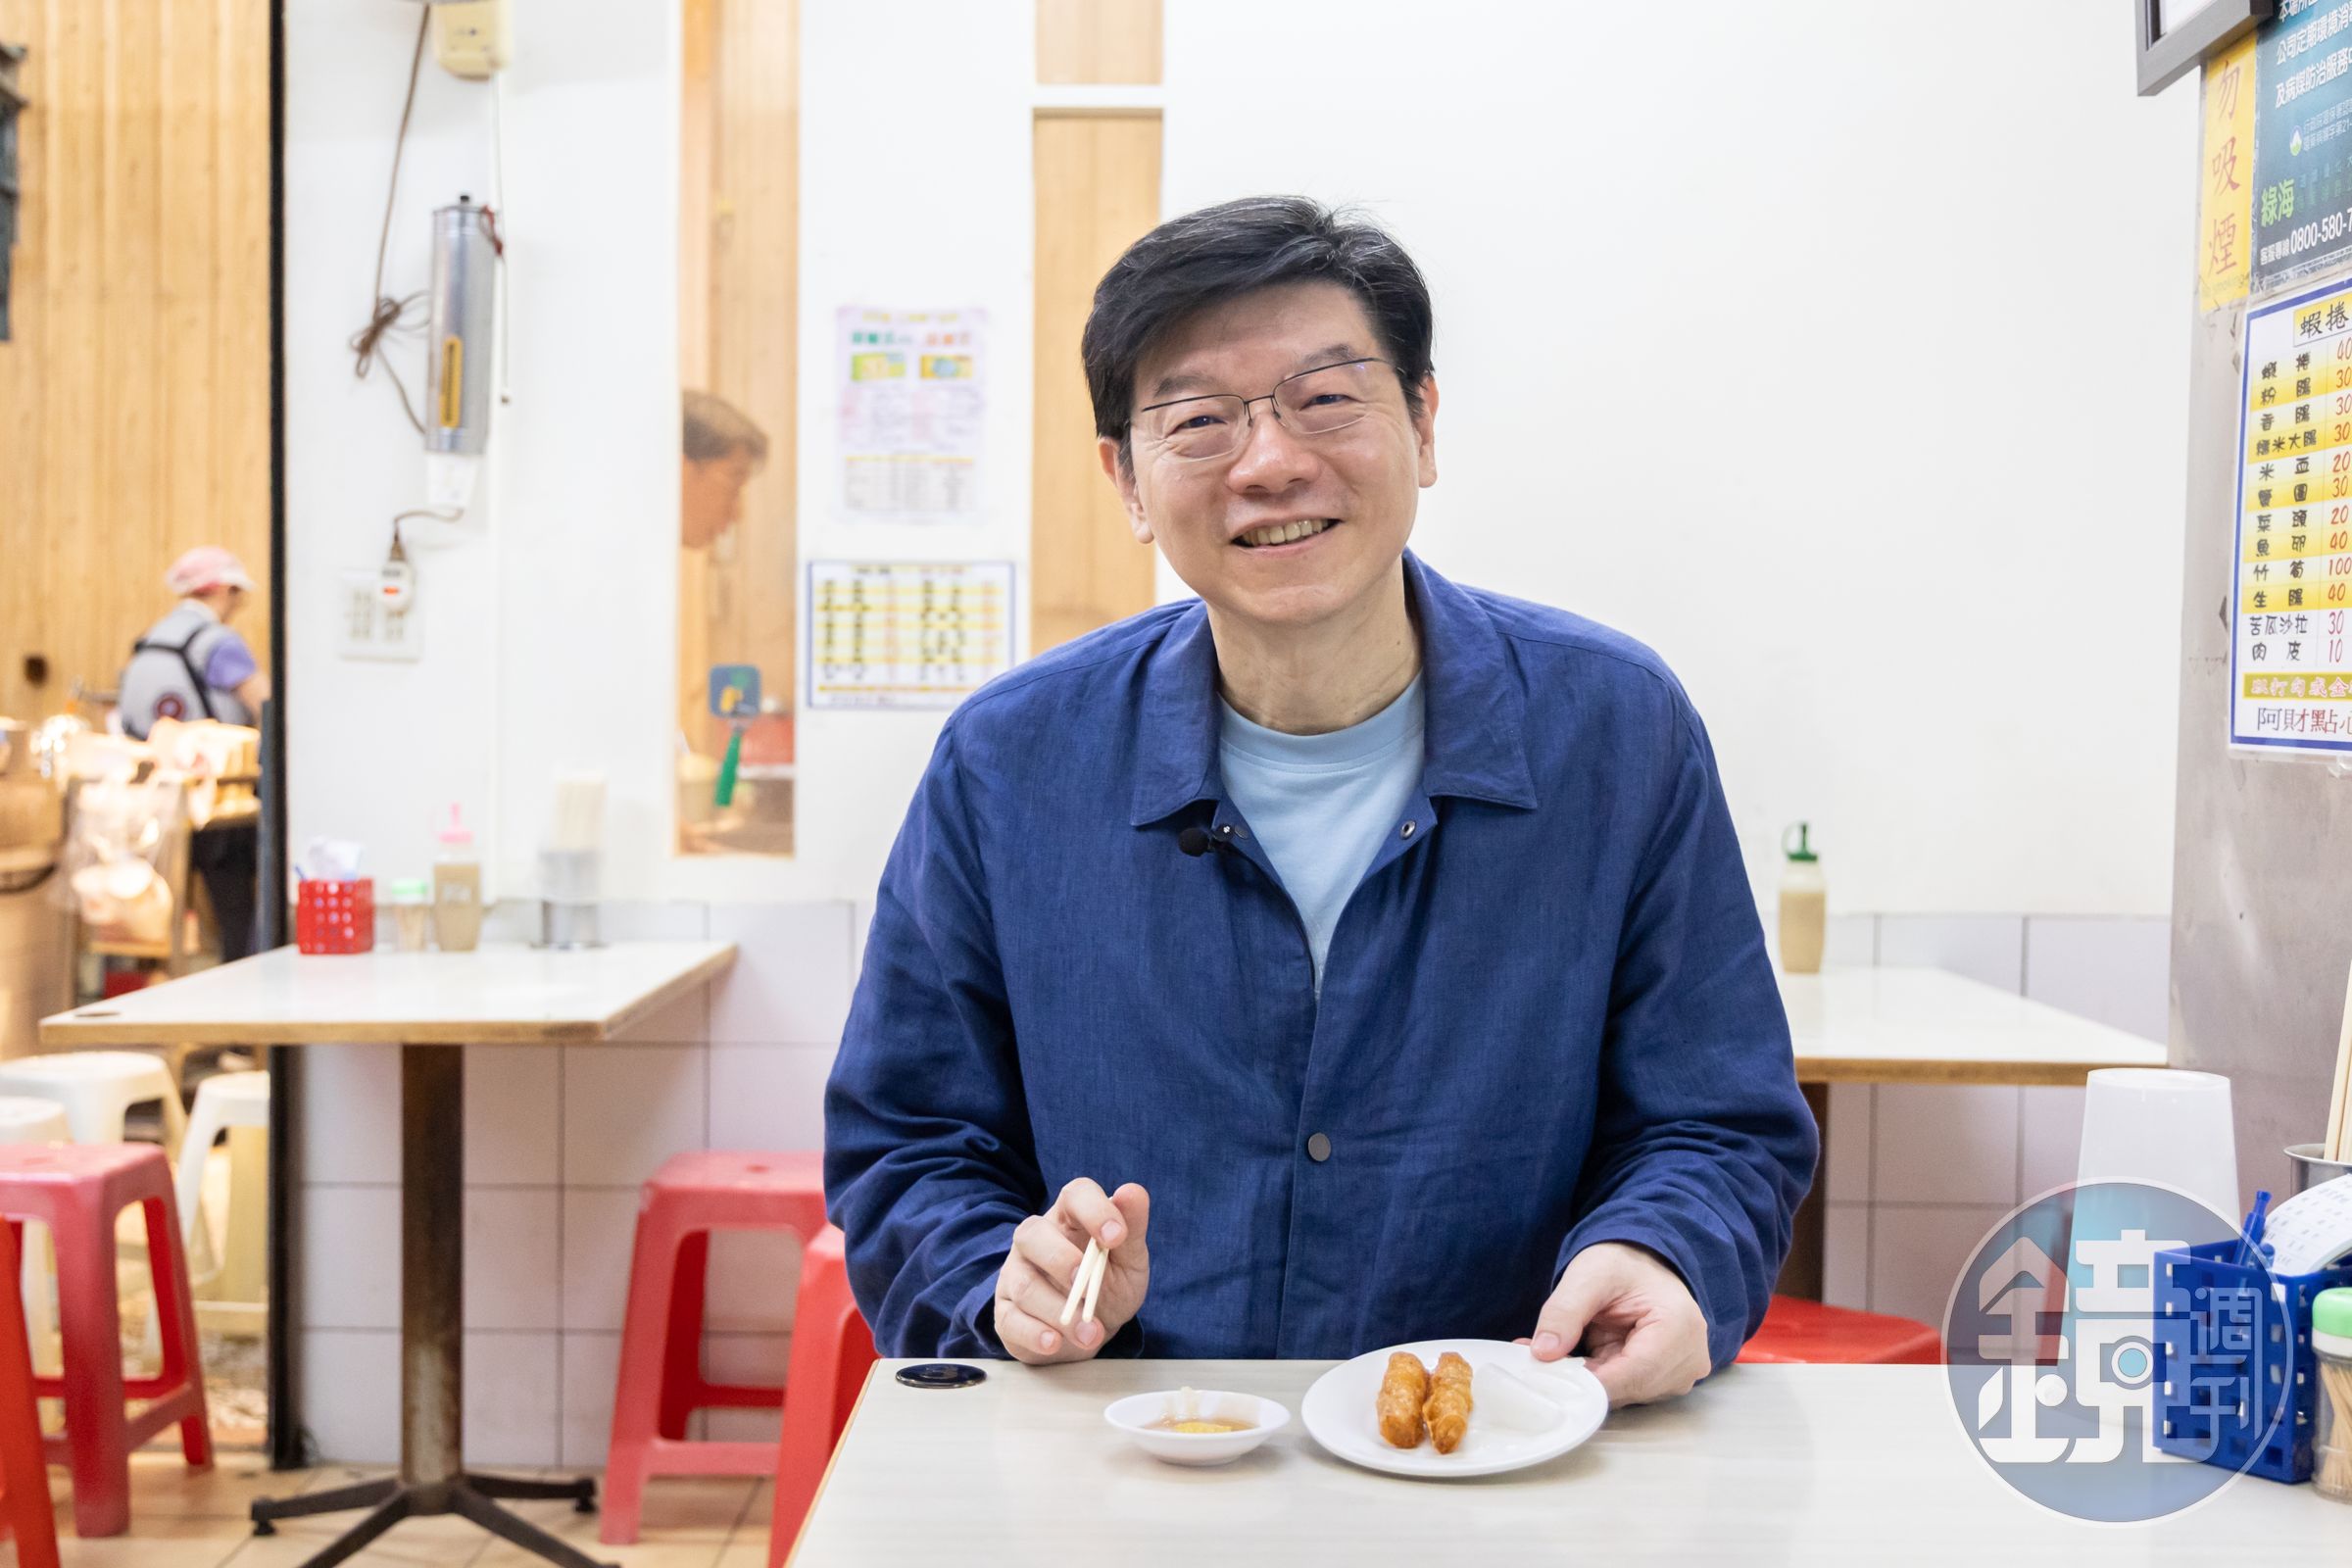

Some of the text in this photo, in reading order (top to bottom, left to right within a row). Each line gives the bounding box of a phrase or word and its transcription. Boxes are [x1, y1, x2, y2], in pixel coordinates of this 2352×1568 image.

[2277, 1, 2352, 65] 公司定期環境消
[2208, 59, 2241, 276] 勿吸煙
[2261, 178, 2294, 227] 綠海
[2300, 301, 2349, 338] 蝦捲
[2336, 367, 2352, 389] 30
[2335, 393, 2352, 416] 30
[2334, 421, 2350, 442] 30
[2332, 451, 2350, 473] 20
[2332, 475, 2349, 498] 30
[2330, 505, 2349, 524] 20
[2330, 530, 2348, 550] 40
[2328, 557, 2352, 576] 100
[2328, 583, 2346, 602] 40
[2249, 611, 2343, 636] 苦瓜沙拉 30
[2328, 638, 2343, 663] 10
